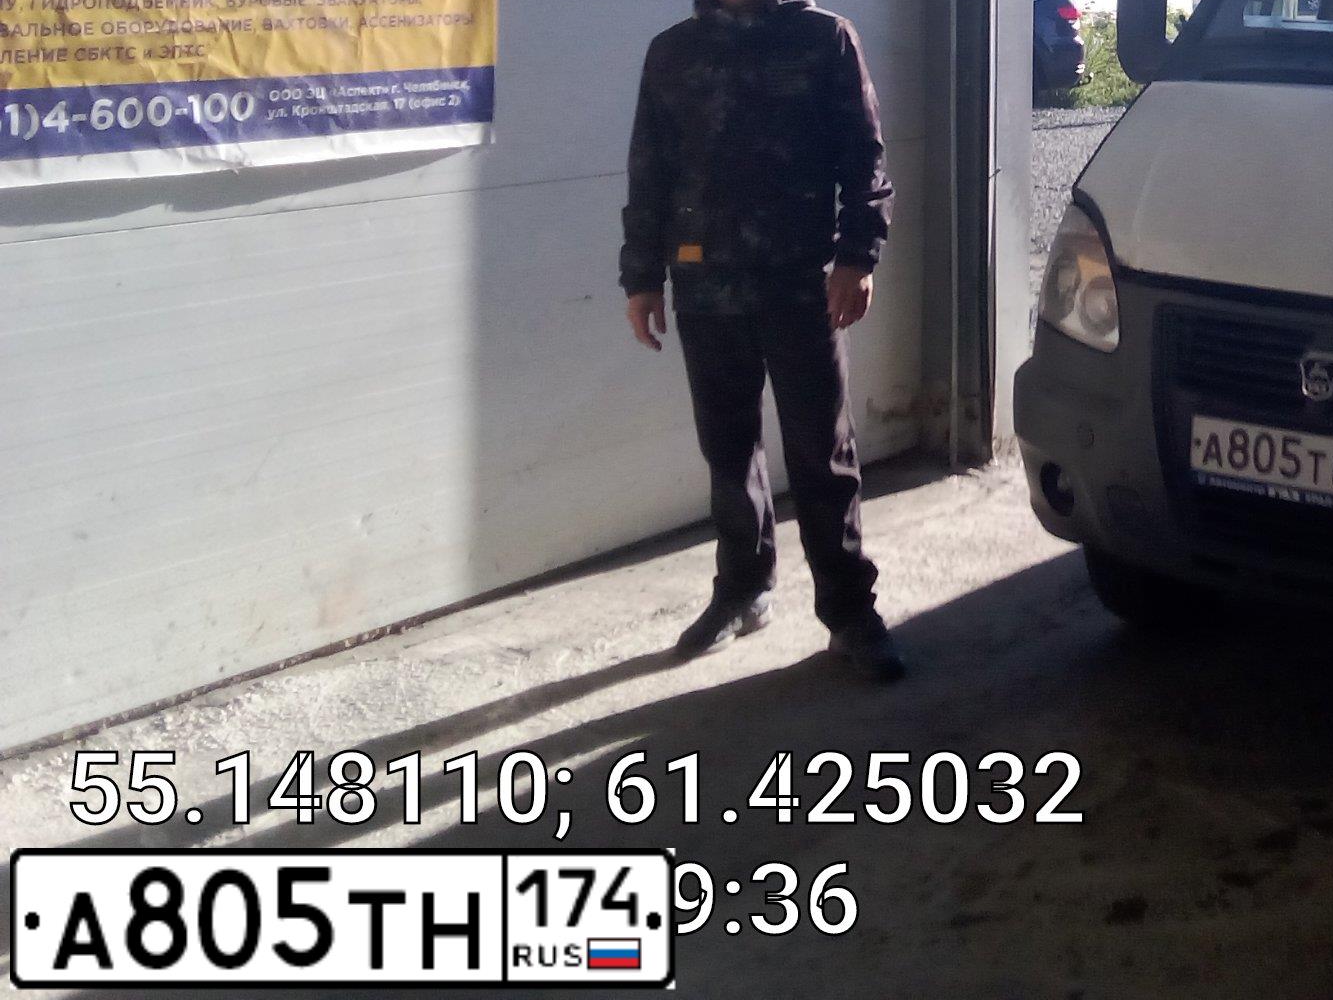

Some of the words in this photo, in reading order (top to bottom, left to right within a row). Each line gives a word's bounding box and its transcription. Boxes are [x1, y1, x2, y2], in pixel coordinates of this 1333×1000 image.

[74, 47, 137, 62] СБКТС
[269, 88, 302, 102] ООО
[0, 92, 254, 141] 1)4-600-100
